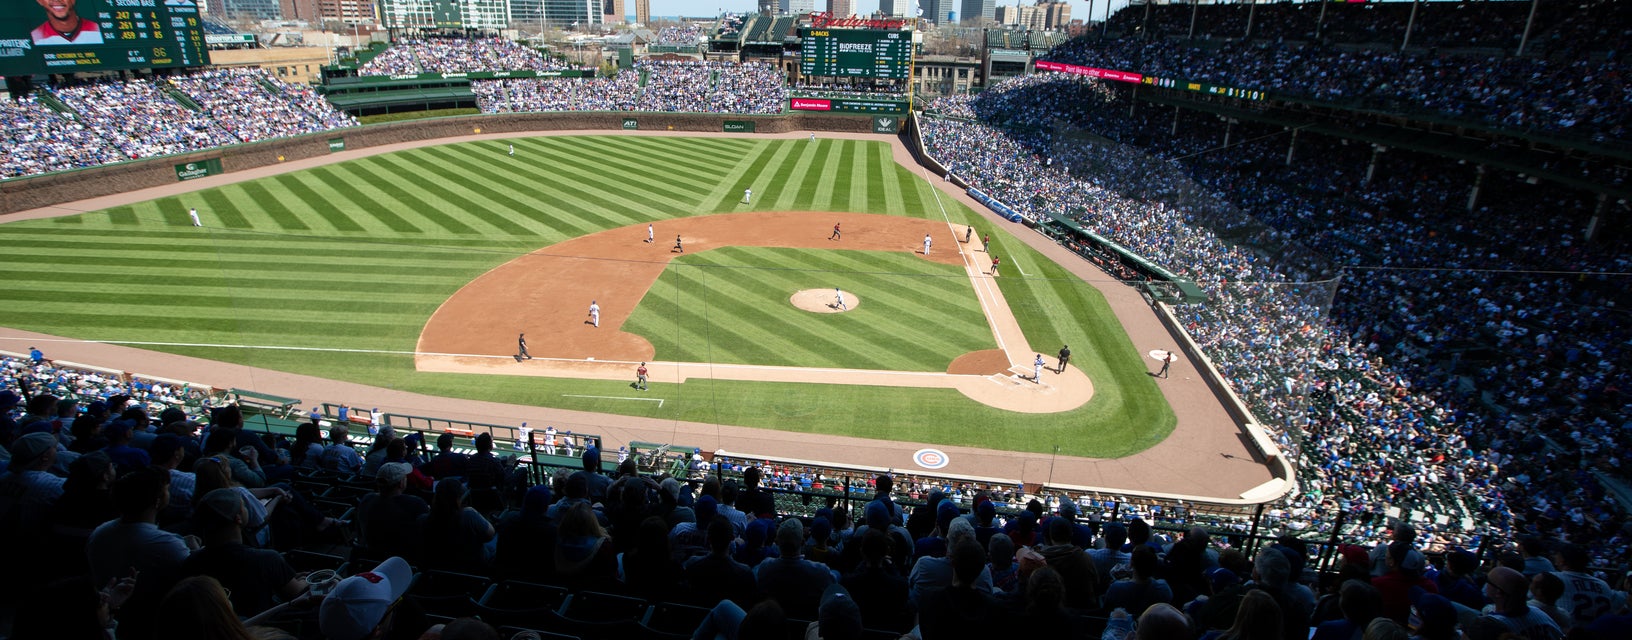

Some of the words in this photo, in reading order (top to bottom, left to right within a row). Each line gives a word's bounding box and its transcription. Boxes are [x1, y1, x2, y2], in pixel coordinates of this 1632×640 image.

[150, 11, 157, 19] 4
[809, 10, 906, 28] Budweiser
[151, 21, 161, 30] 15
[187, 17, 197, 27] 19
[0, 39, 32, 50] PROTEINS
[152, 48, 167, 58] 86
[1065, 65, 1076, 73] Paint
[178, 169, 207, 177] Gallagher
